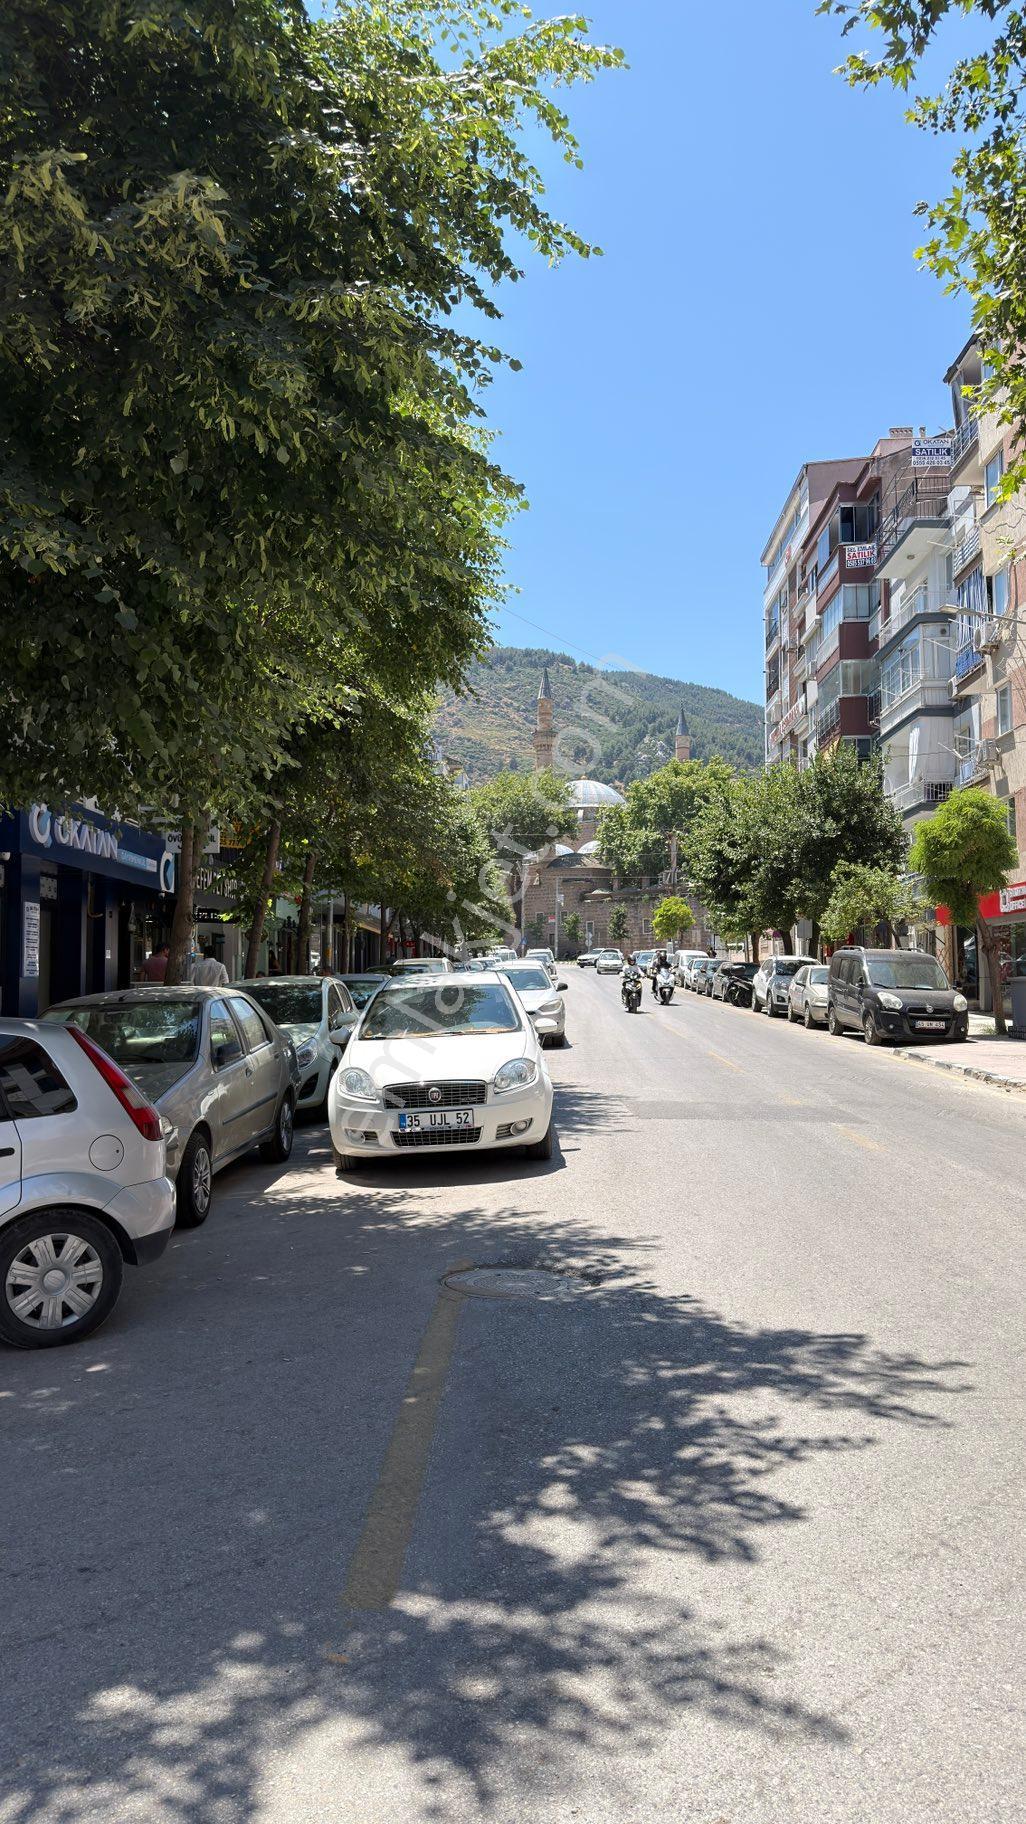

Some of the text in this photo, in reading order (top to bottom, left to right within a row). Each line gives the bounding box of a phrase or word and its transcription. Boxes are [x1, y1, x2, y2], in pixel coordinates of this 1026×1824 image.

[915, 448, 948, 456] SATILIK
[847, 550, 875, 560] SATILIK
[407, 1112, 470, 1127] 35 UJL 52
